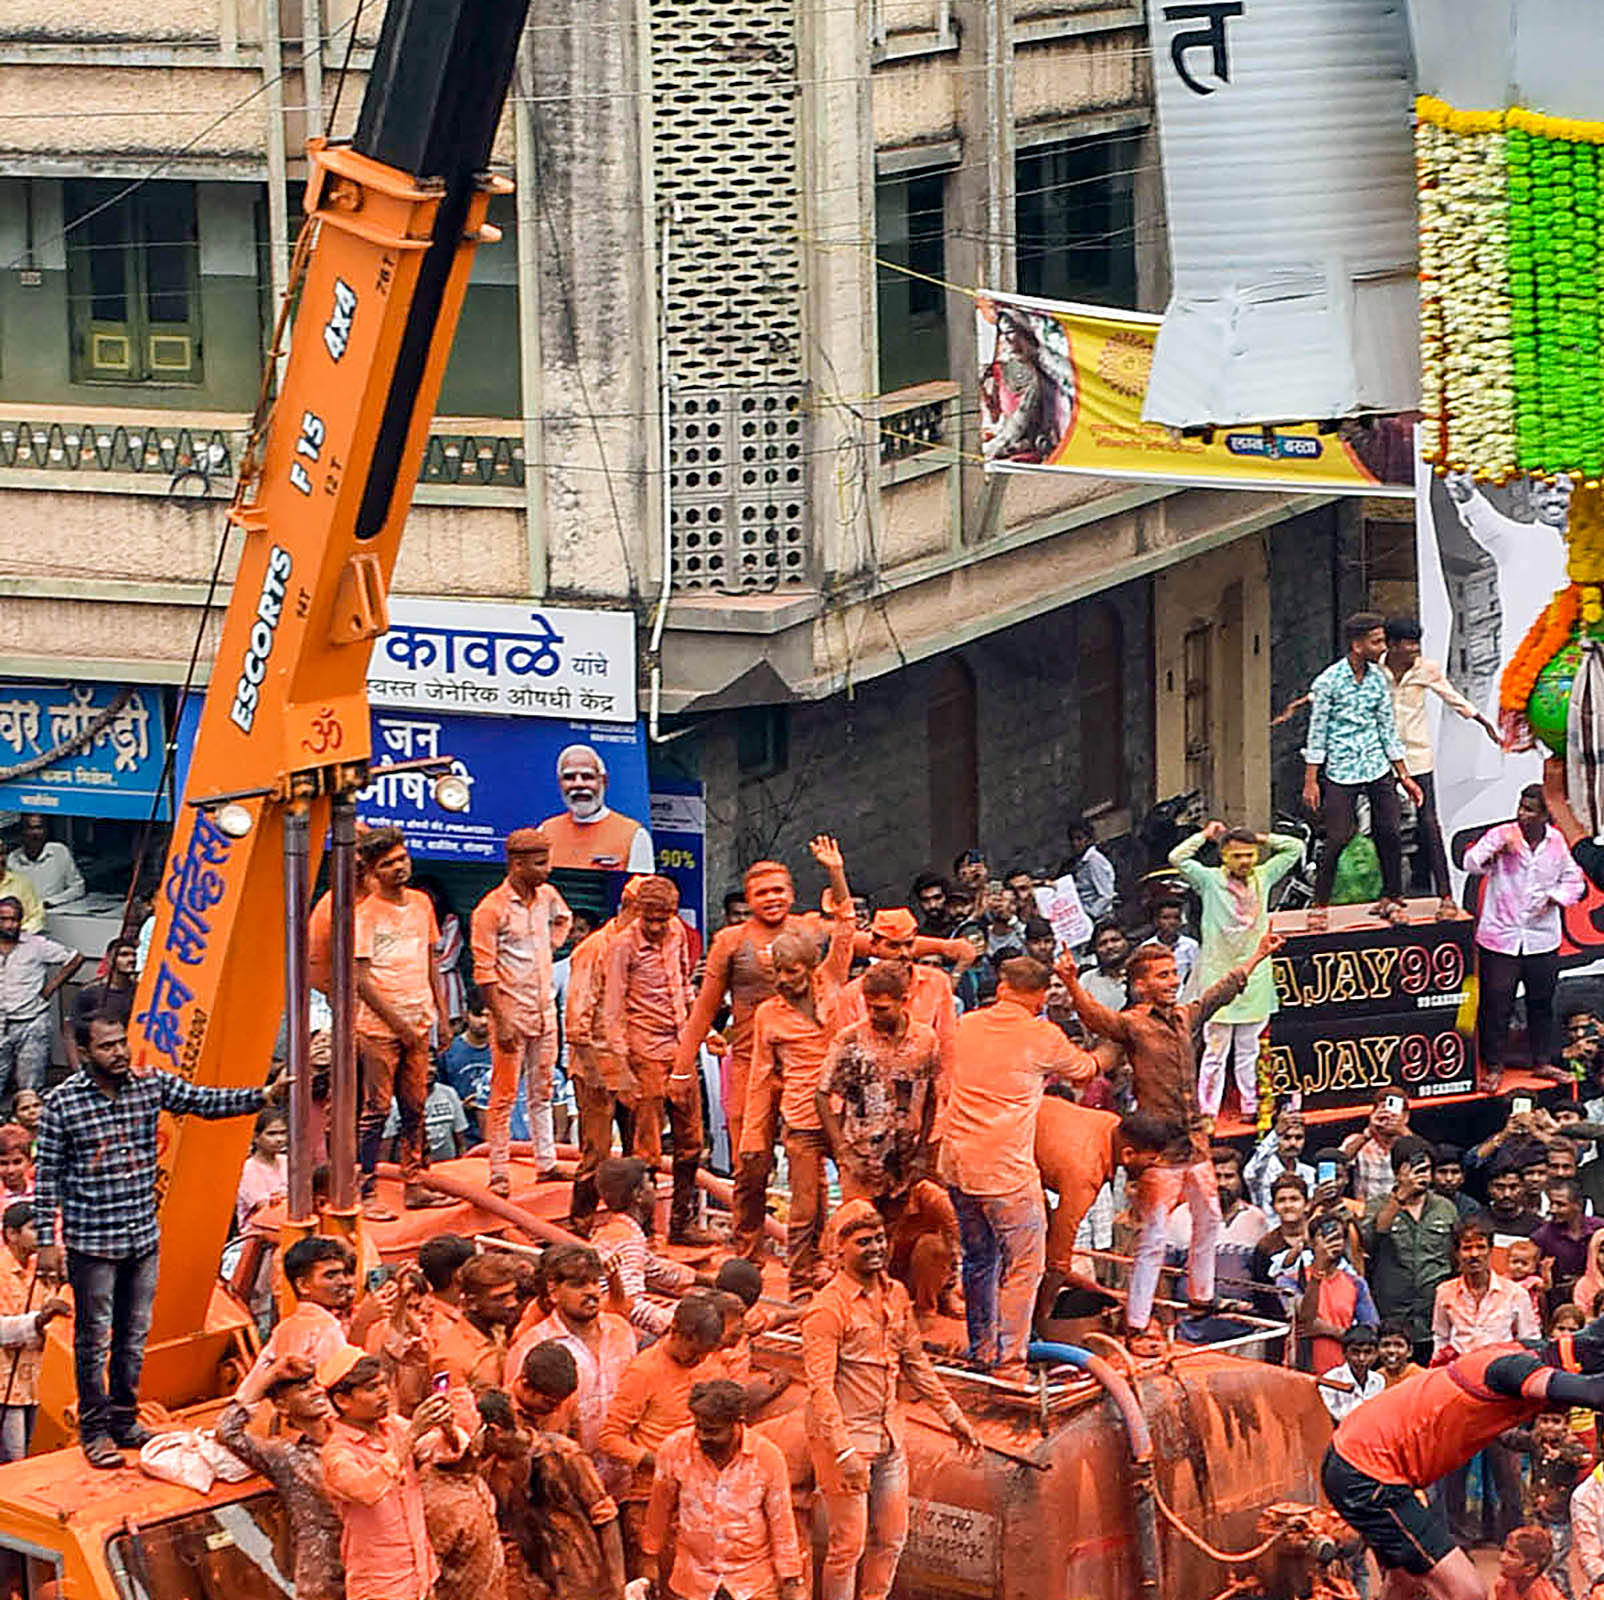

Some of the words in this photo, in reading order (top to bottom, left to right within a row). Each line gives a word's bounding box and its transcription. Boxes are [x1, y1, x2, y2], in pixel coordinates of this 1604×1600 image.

[230, 545, 294, 736] ESCORTS
[386, 613, 564, 677] कावळे
[378, 719, 442, 759] जन
